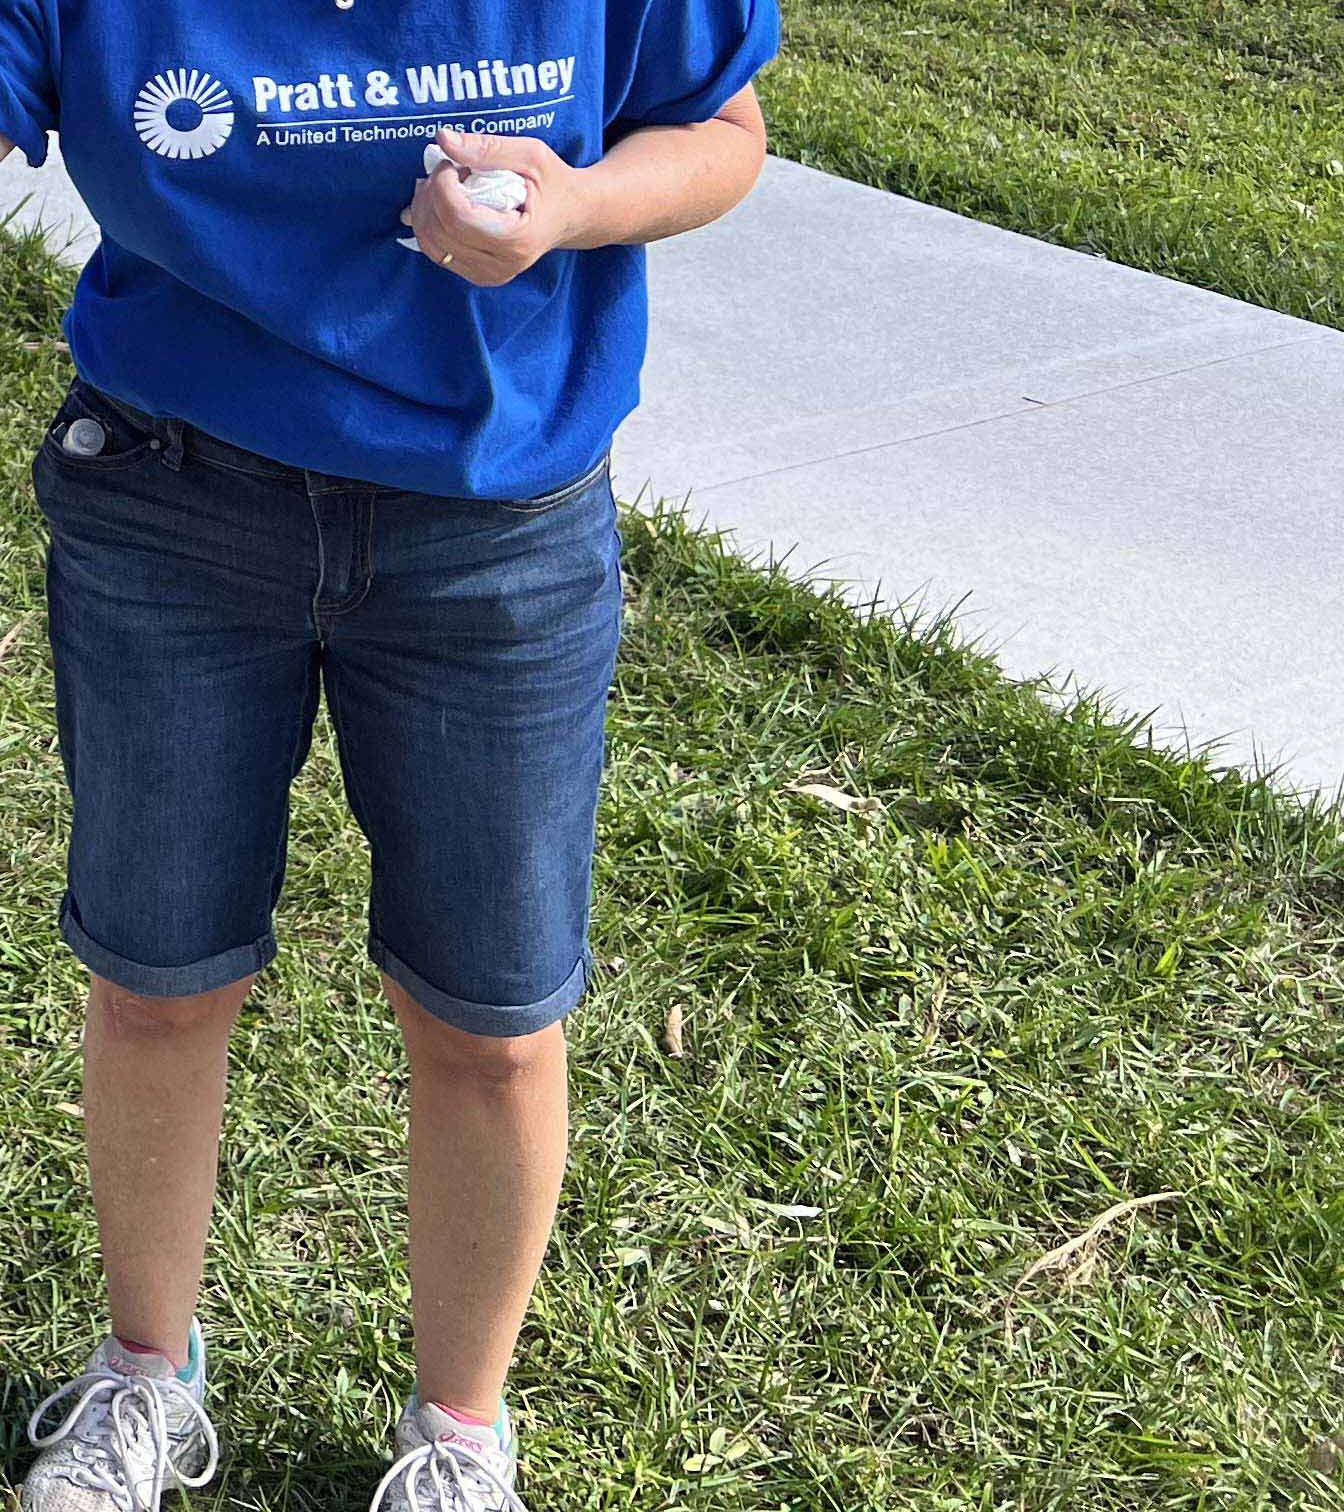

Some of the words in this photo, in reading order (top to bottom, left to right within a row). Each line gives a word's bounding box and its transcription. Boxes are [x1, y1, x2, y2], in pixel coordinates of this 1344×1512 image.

[252, 74, 356, 113] Pratt
[365, 70, 399, 107] &
[406, 56, 576, 104] Whitney
[256, 130, 271, 146] A
[275, 127, 337, 145] United
[470, 112, 555, 136] Company
